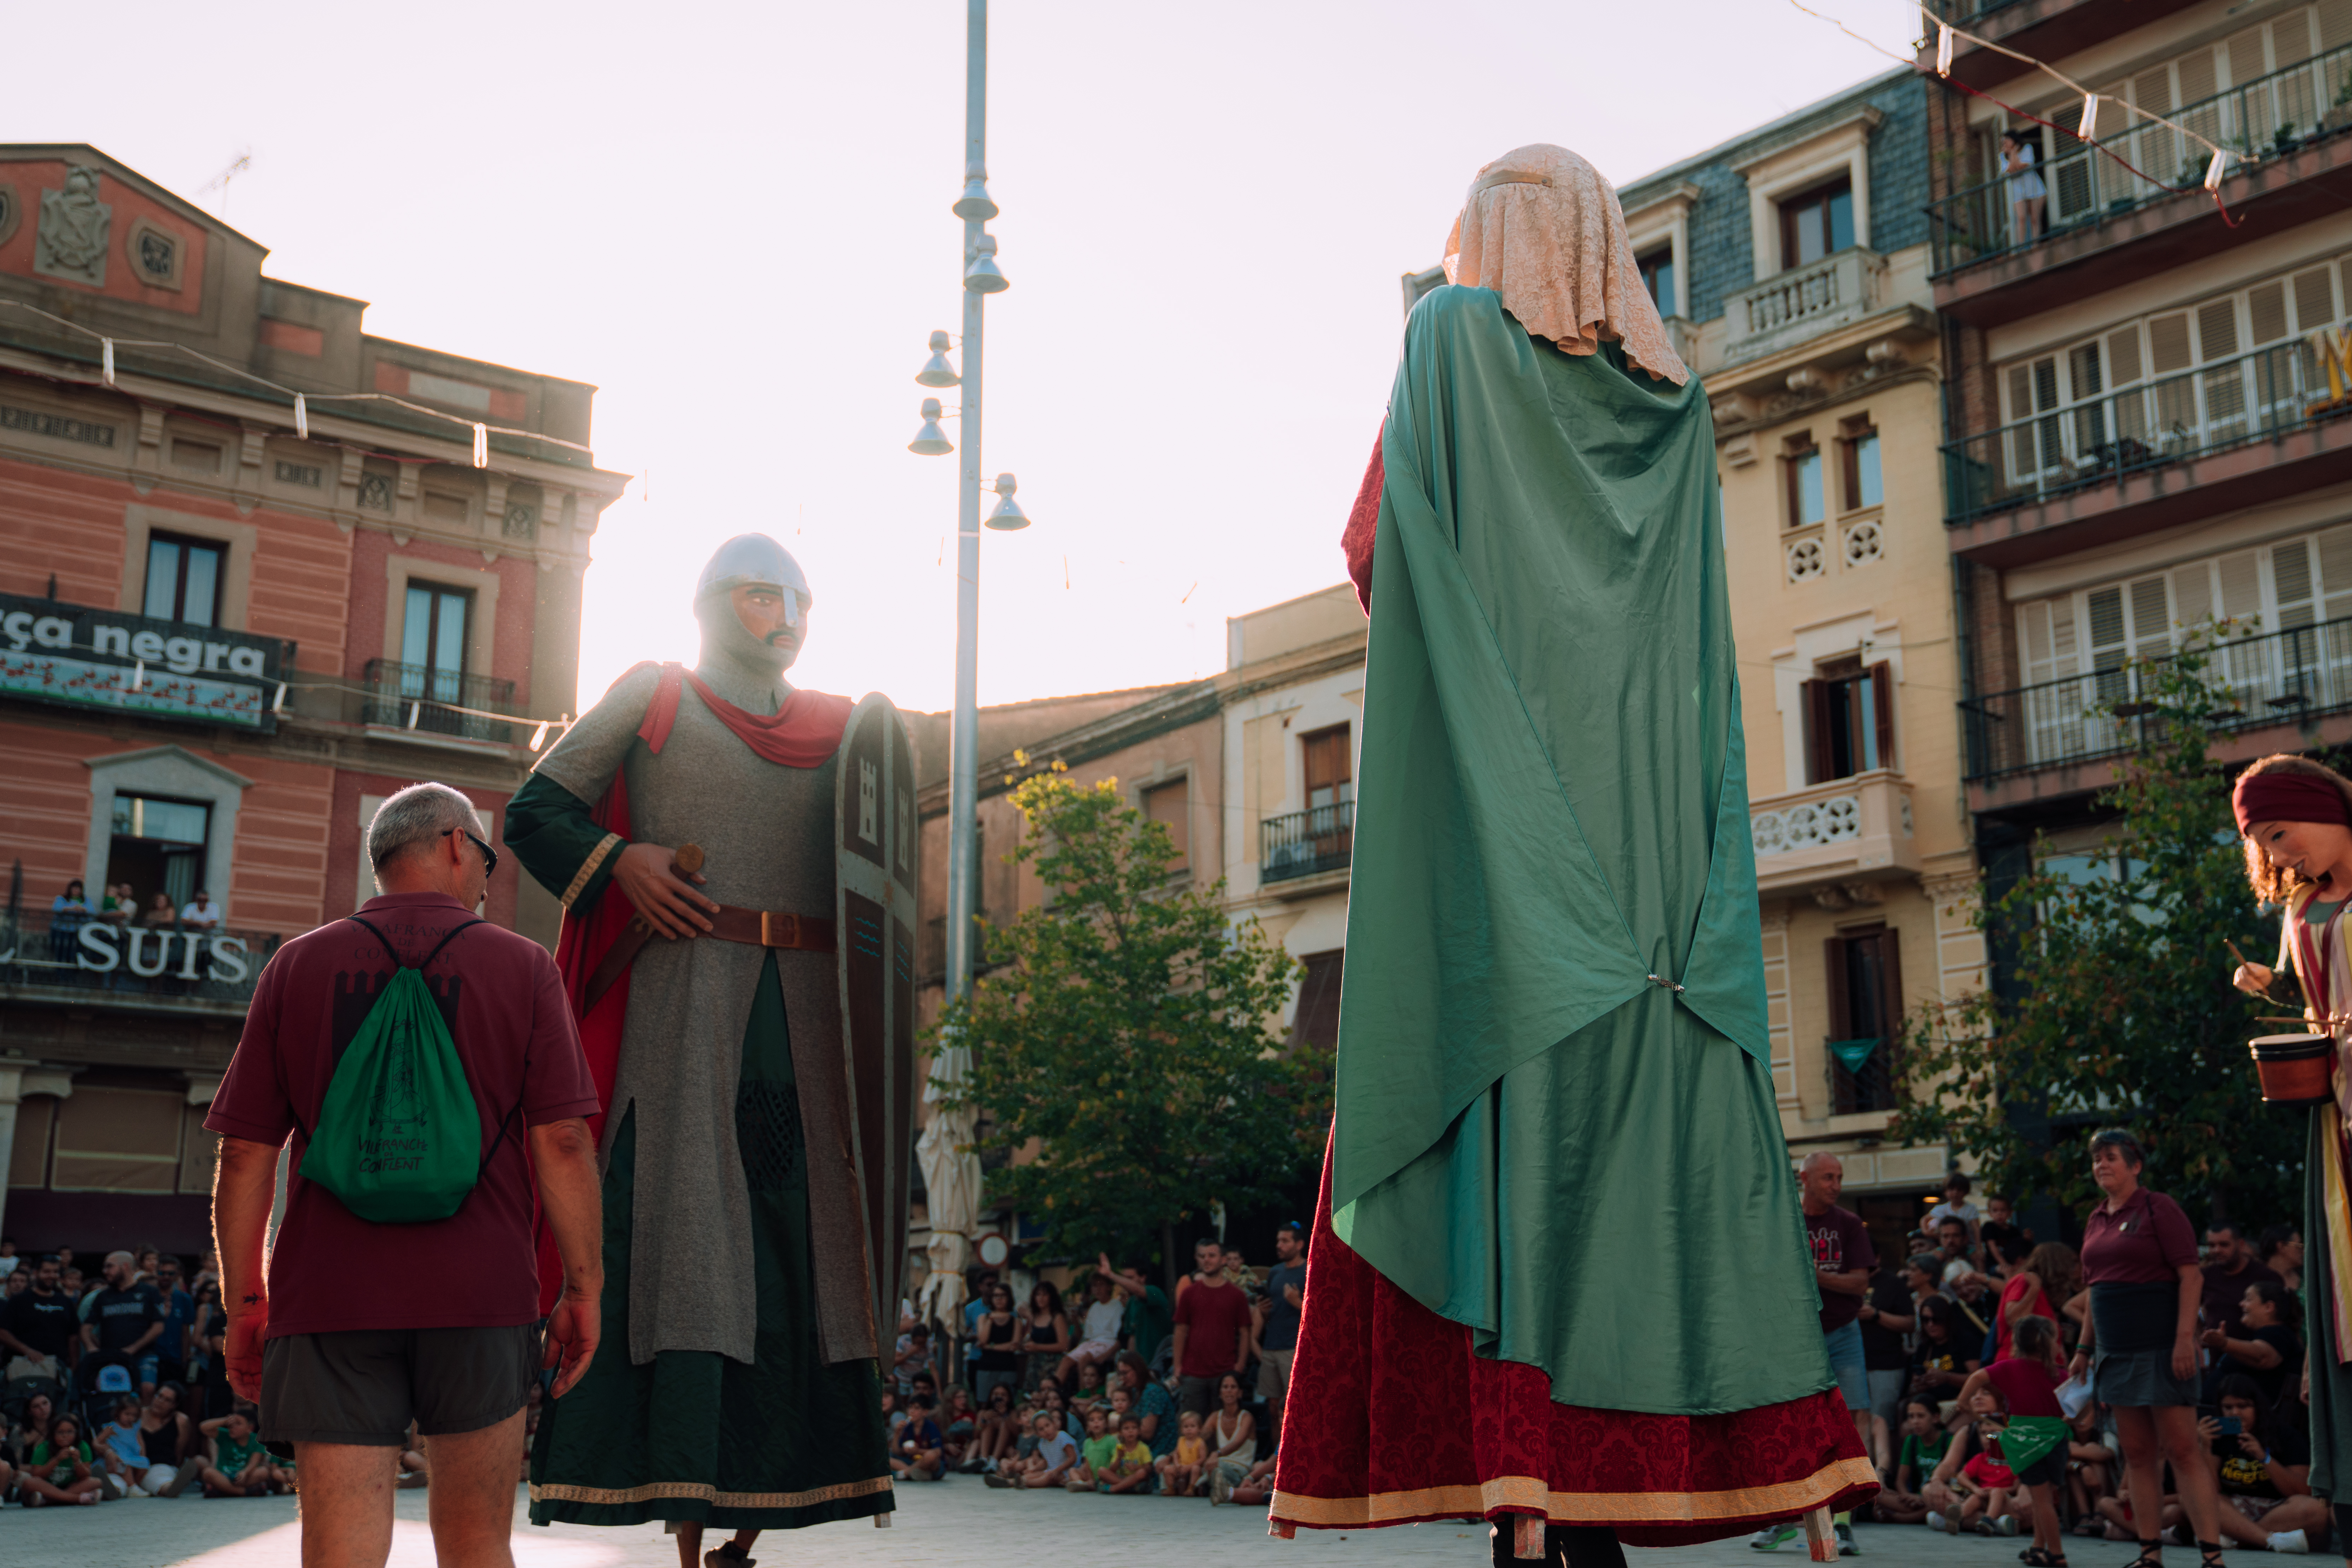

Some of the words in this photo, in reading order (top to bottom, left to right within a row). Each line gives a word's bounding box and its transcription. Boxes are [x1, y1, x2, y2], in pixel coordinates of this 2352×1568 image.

[92, 624, 265, 675] negra
[76, 922, 248, 984] SUIS
[398, 937, 414, 947] DE
[359, 1157, 425, 1174] CONFLENT
